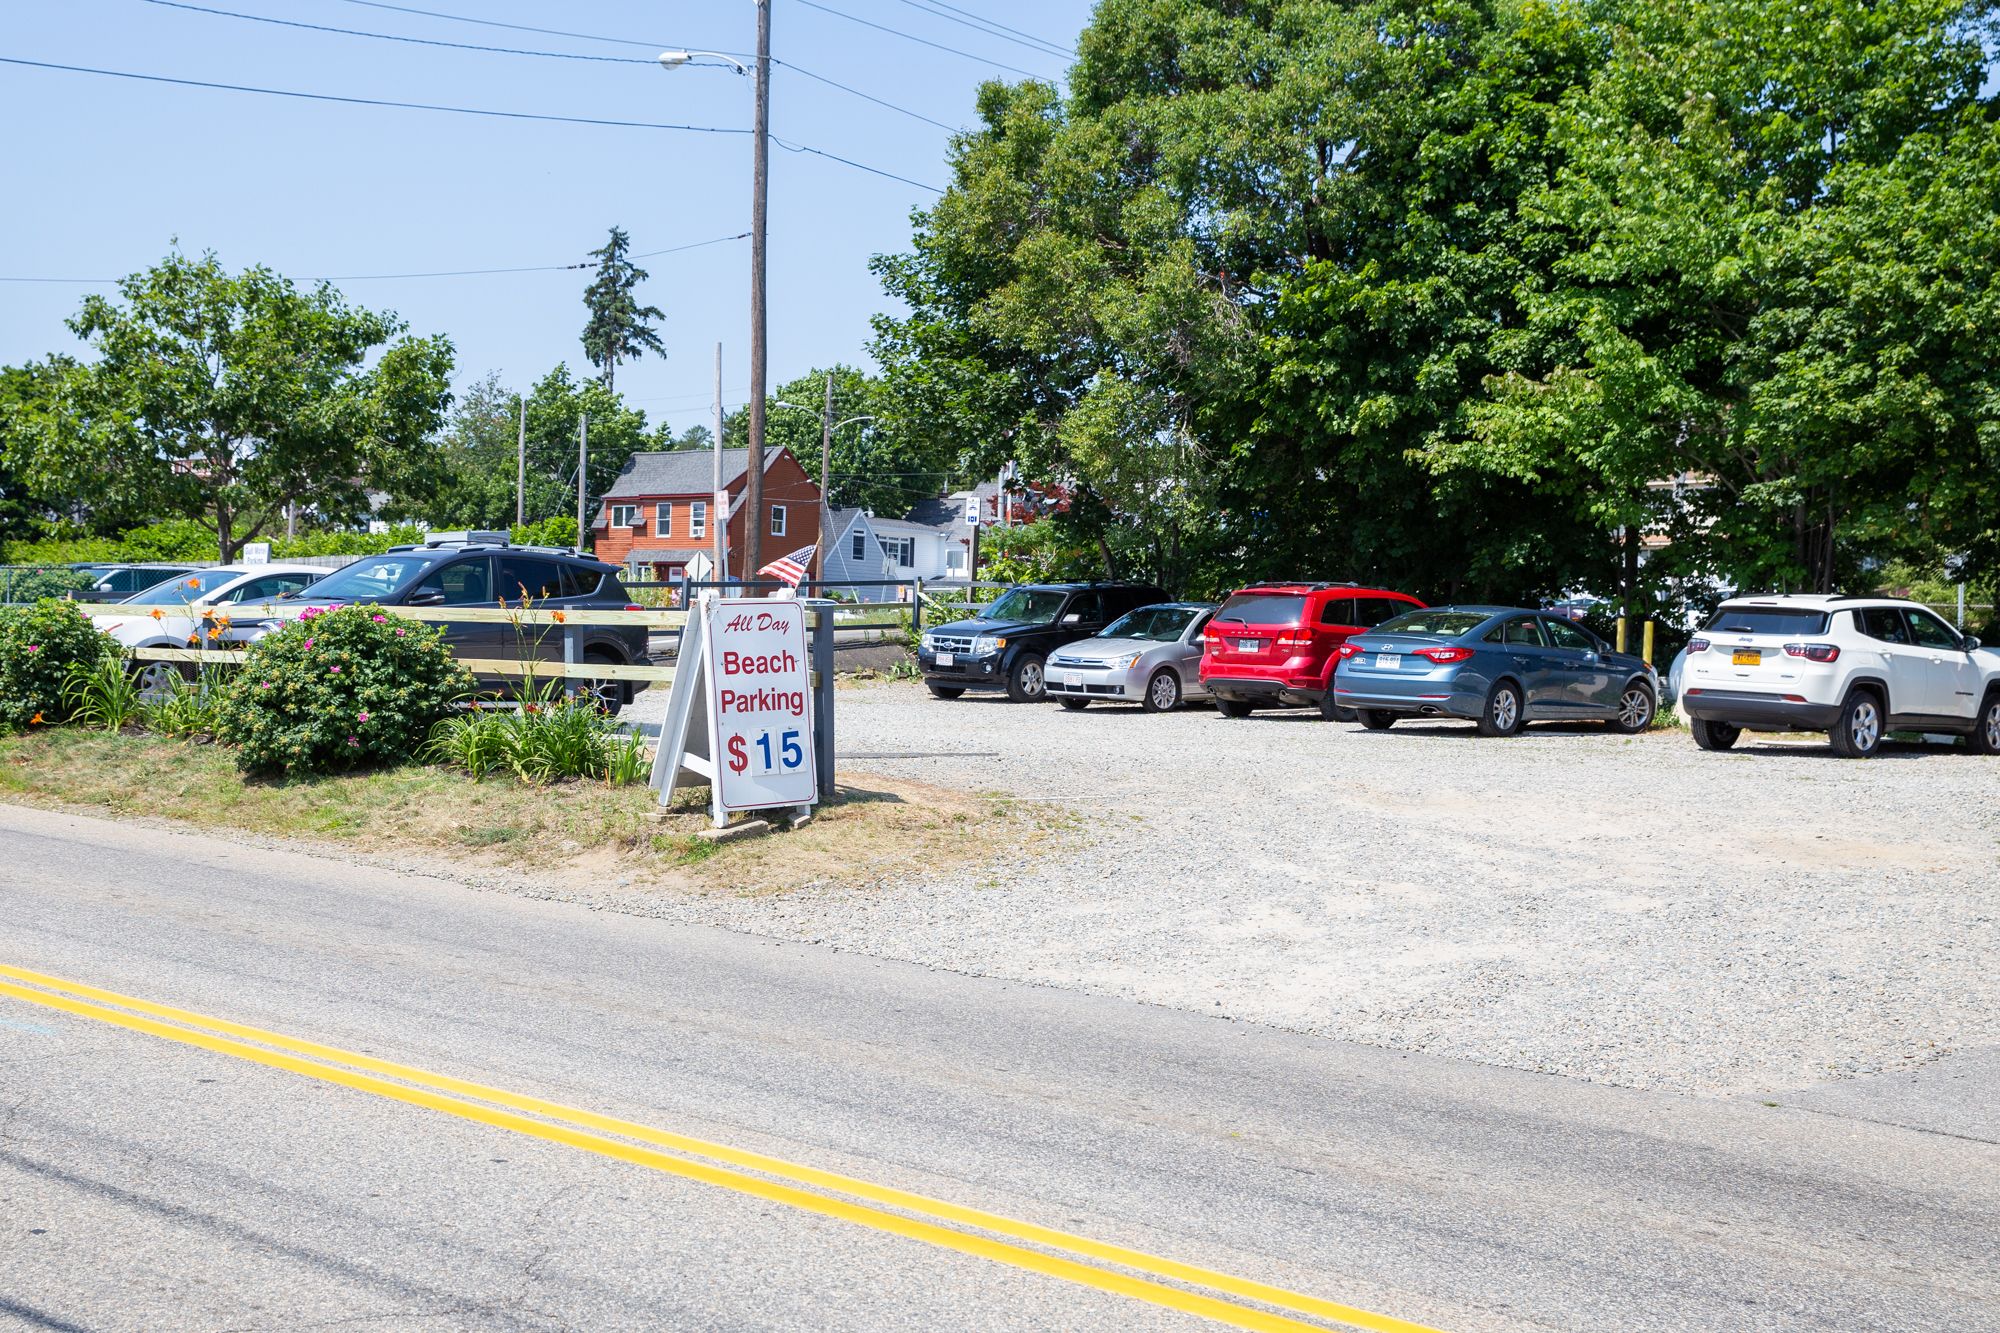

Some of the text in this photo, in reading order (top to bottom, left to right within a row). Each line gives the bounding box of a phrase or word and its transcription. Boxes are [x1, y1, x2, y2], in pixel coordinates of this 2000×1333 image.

[724, 612, 790, 636] All Day
[723, 650, 796, 675] Beach
[721, 687, 804, 716] Parking
[727, 730, 803, 776] $15
